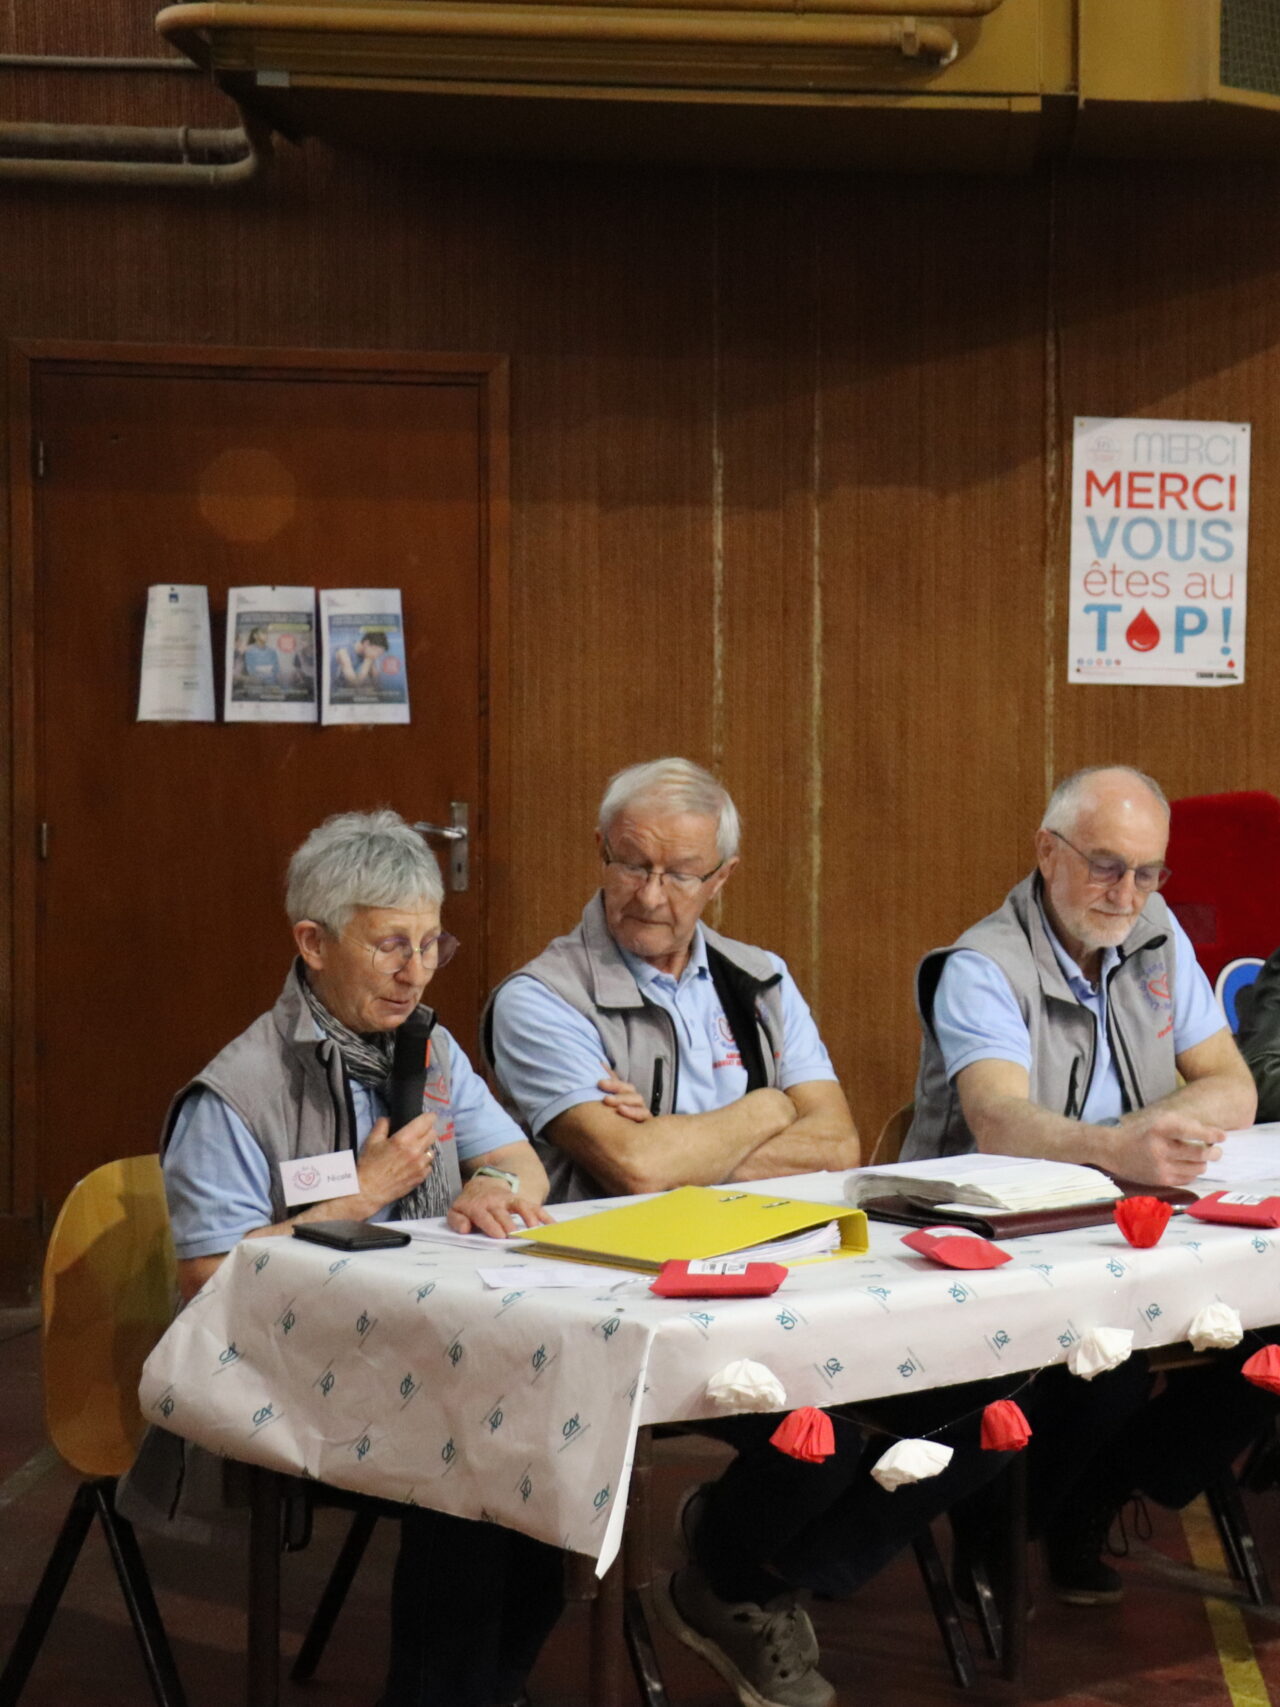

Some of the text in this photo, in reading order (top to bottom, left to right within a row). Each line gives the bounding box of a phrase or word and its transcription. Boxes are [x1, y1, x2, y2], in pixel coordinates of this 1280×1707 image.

[1084, 469, 1237, 512] MERCI
[1085, 516, 1234, 563] VOUS
[1083, 560, 1234, 600] êtes au
